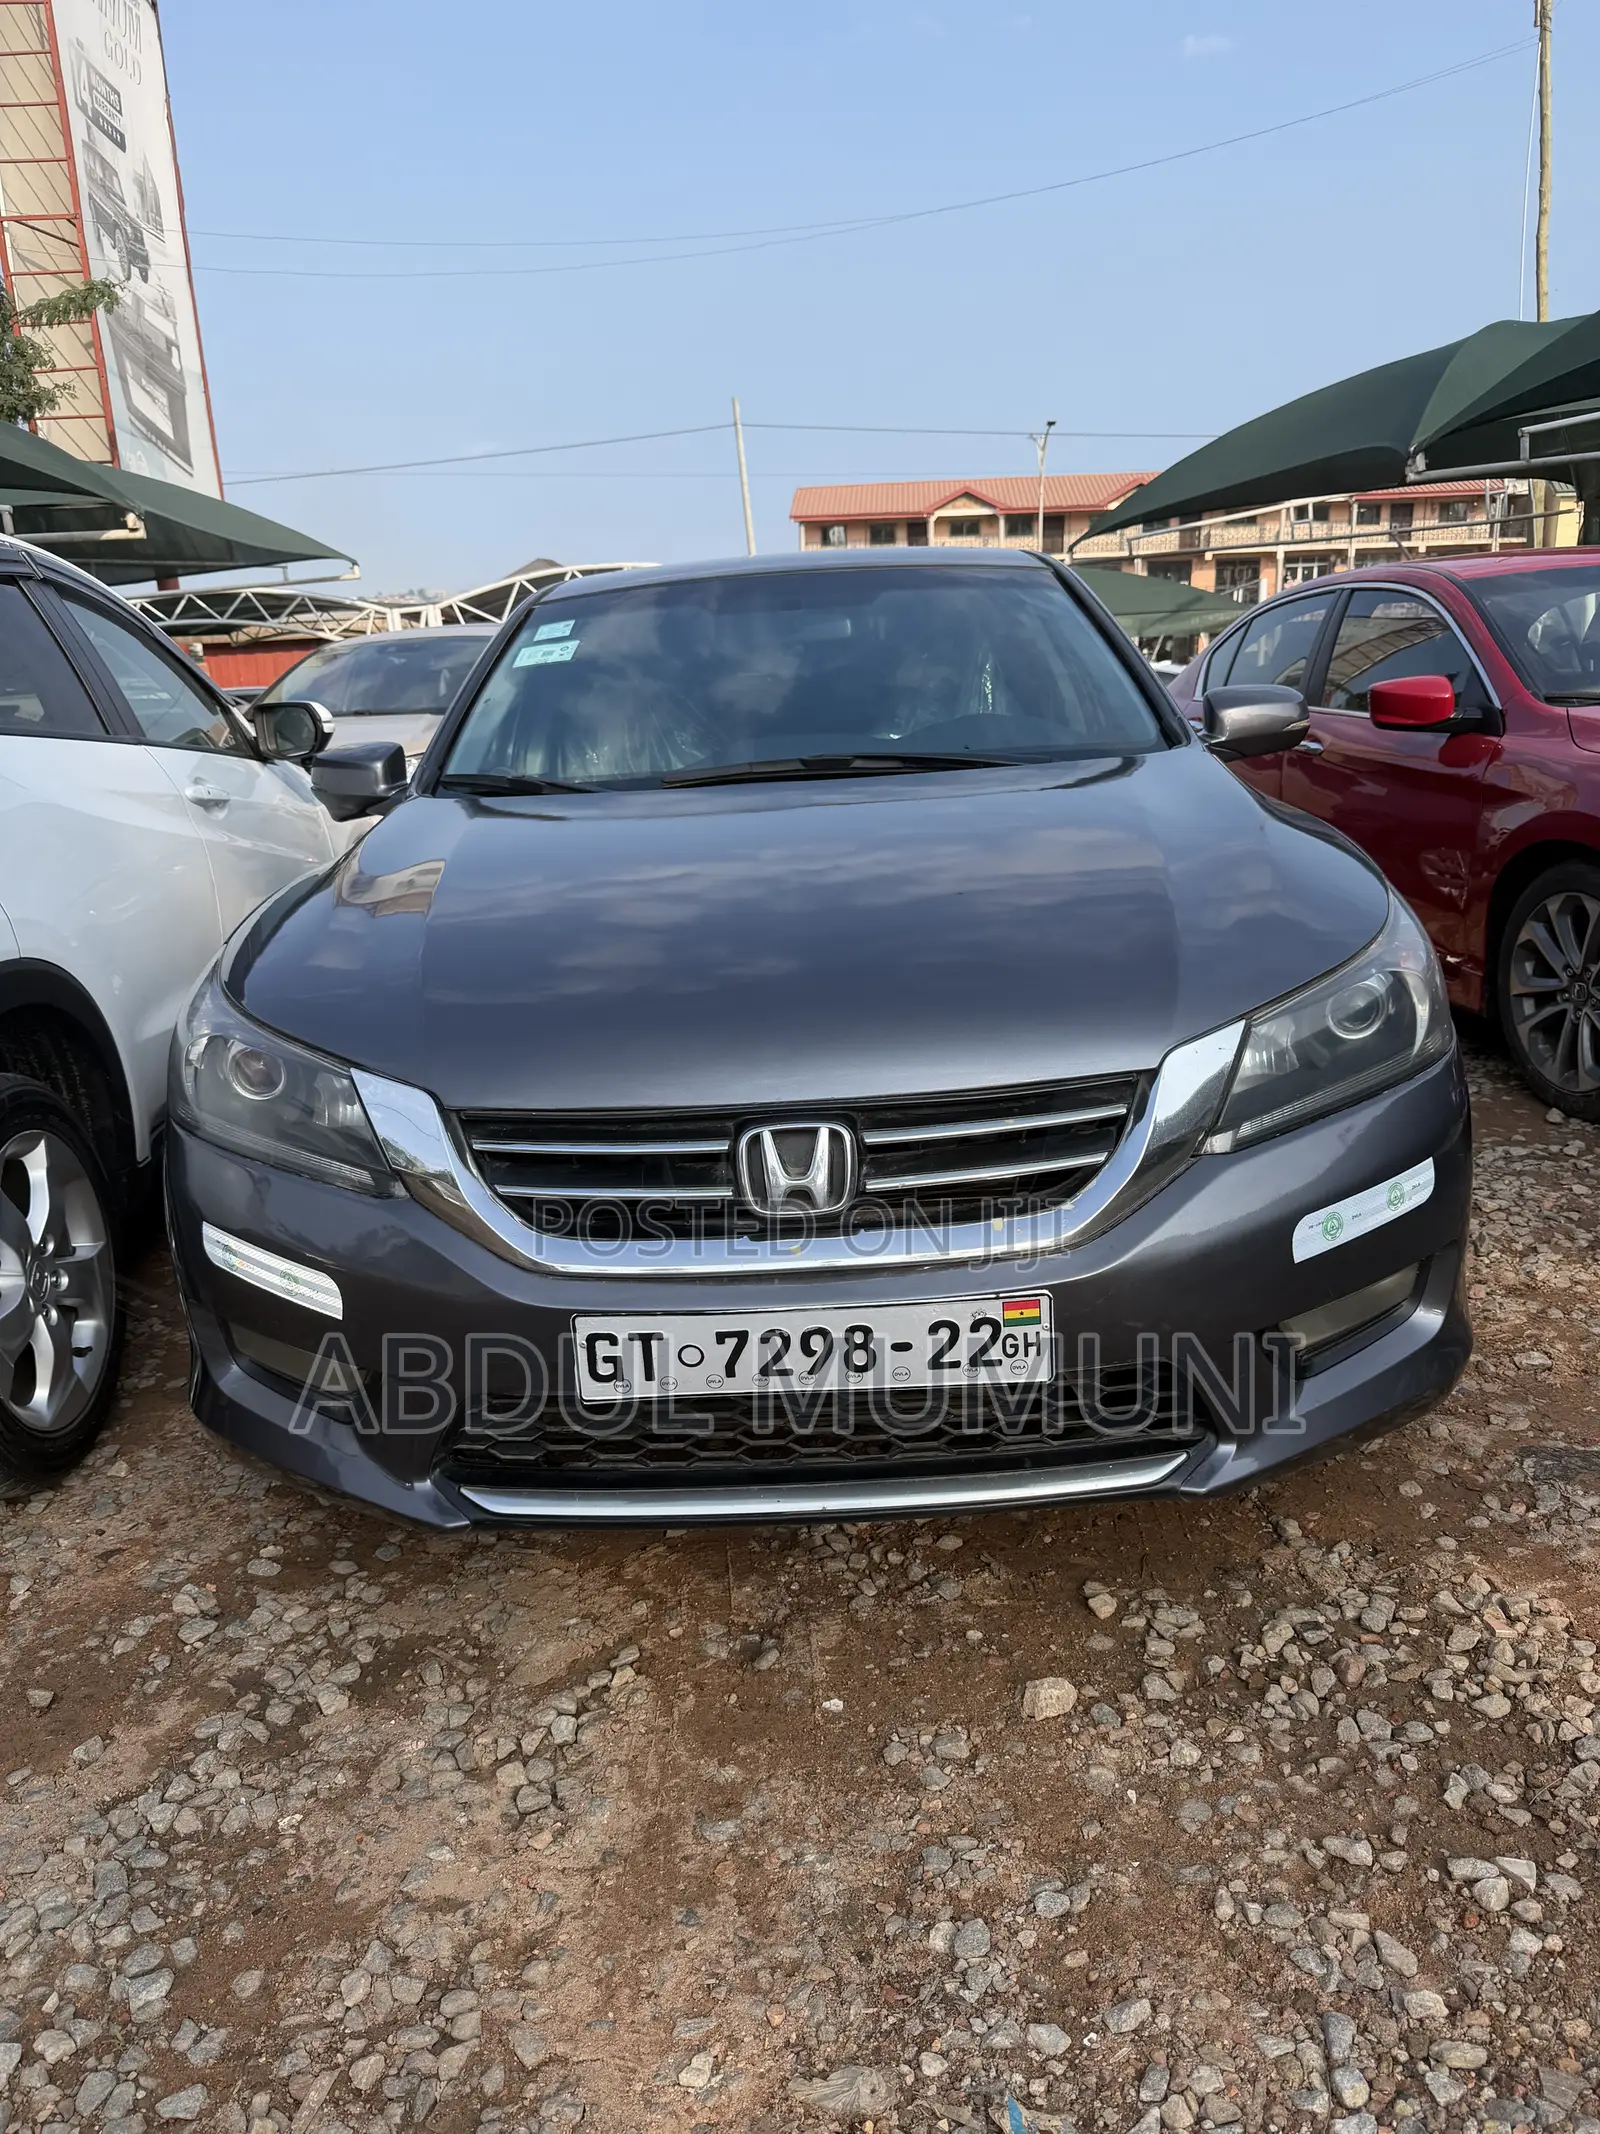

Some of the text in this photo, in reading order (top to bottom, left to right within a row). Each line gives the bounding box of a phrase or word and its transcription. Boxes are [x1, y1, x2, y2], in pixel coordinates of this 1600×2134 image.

[104, 28, 141, 86] GOLD
[90, 68, 120, 112] MONTHS
[586, 1332, 664, 1382] GT
[1002, 1331, 1041, 1359] GH
